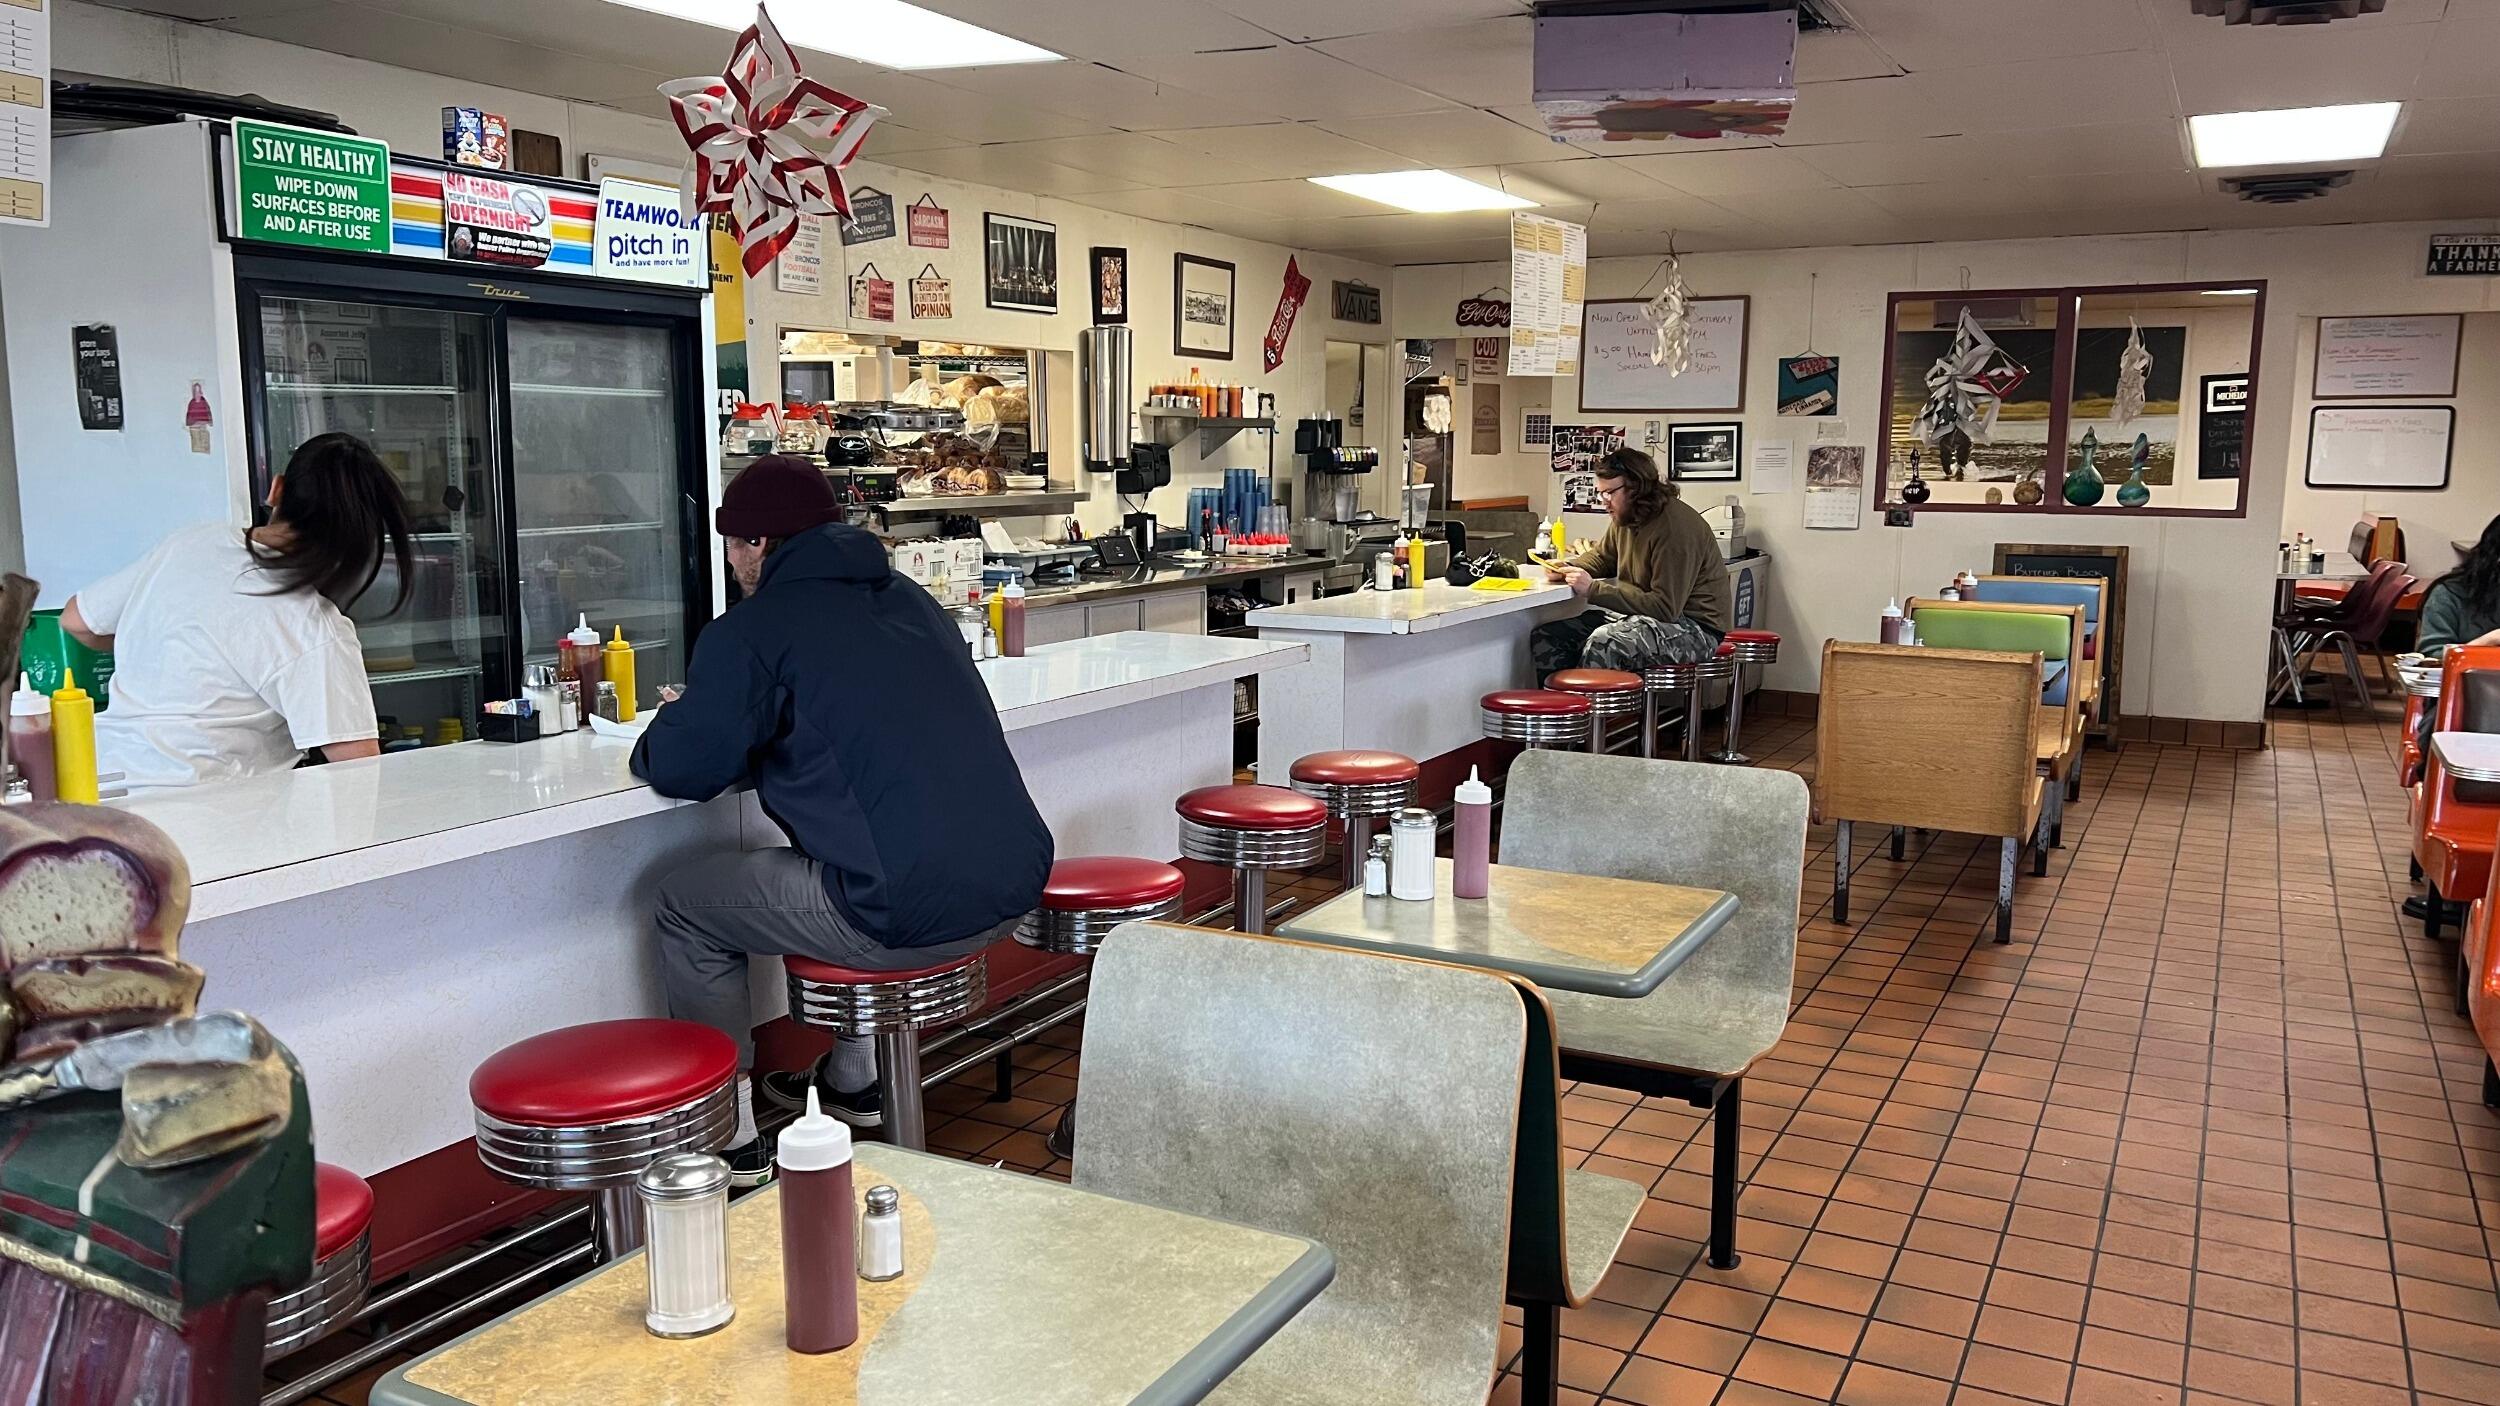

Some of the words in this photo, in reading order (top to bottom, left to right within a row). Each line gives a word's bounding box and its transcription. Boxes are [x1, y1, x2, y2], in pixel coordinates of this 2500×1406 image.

[252, 136, 295, 164] STAY
[300, 144, 375, 176] HEALTHY
[275, 175, 311, 195] WIPE
[314, 181, 358, 201] DOWN
[446, 171, 467, 193] NO
[470, 177, 510, 201] CASH
[252, 192, 326, 217] SURFACES
[328, 202, 381, 223] BEFORE
[450, 203, 531, 232] OVERNIGHT
[264, 214, 296, 232] AND
[298, 219, 341, 237] AFTER
[345, 224, 371, 241] USE
[479, 232, 491, 243] We
[492, 235, 520, 248] partner
[521, 238, 537, 250] with
[609, 233, 663, 264] pitch
[673, 233, 689, 255] in
[616, 259, 630, 267] and
[633, 258, 651, 267] have
[784, 262, 817, 274] FOOTBALL
[795, 255, 820, 265] BRONCOS
[2429, 261, 2437, 272] A
[2446, 261, 2500, 272] FARME
[914, 303, 951, 318] OPINION
[1337, 286, 1379, 322] VANS
[1616, 311, 1639, 323] OPEN
[320, 328, 348, 338] Assorted
[350, 328, 366, 340] Jelly
[1475, 338, 1498, 356] COD
[2066, 565, 2103, 577] BLOCK
